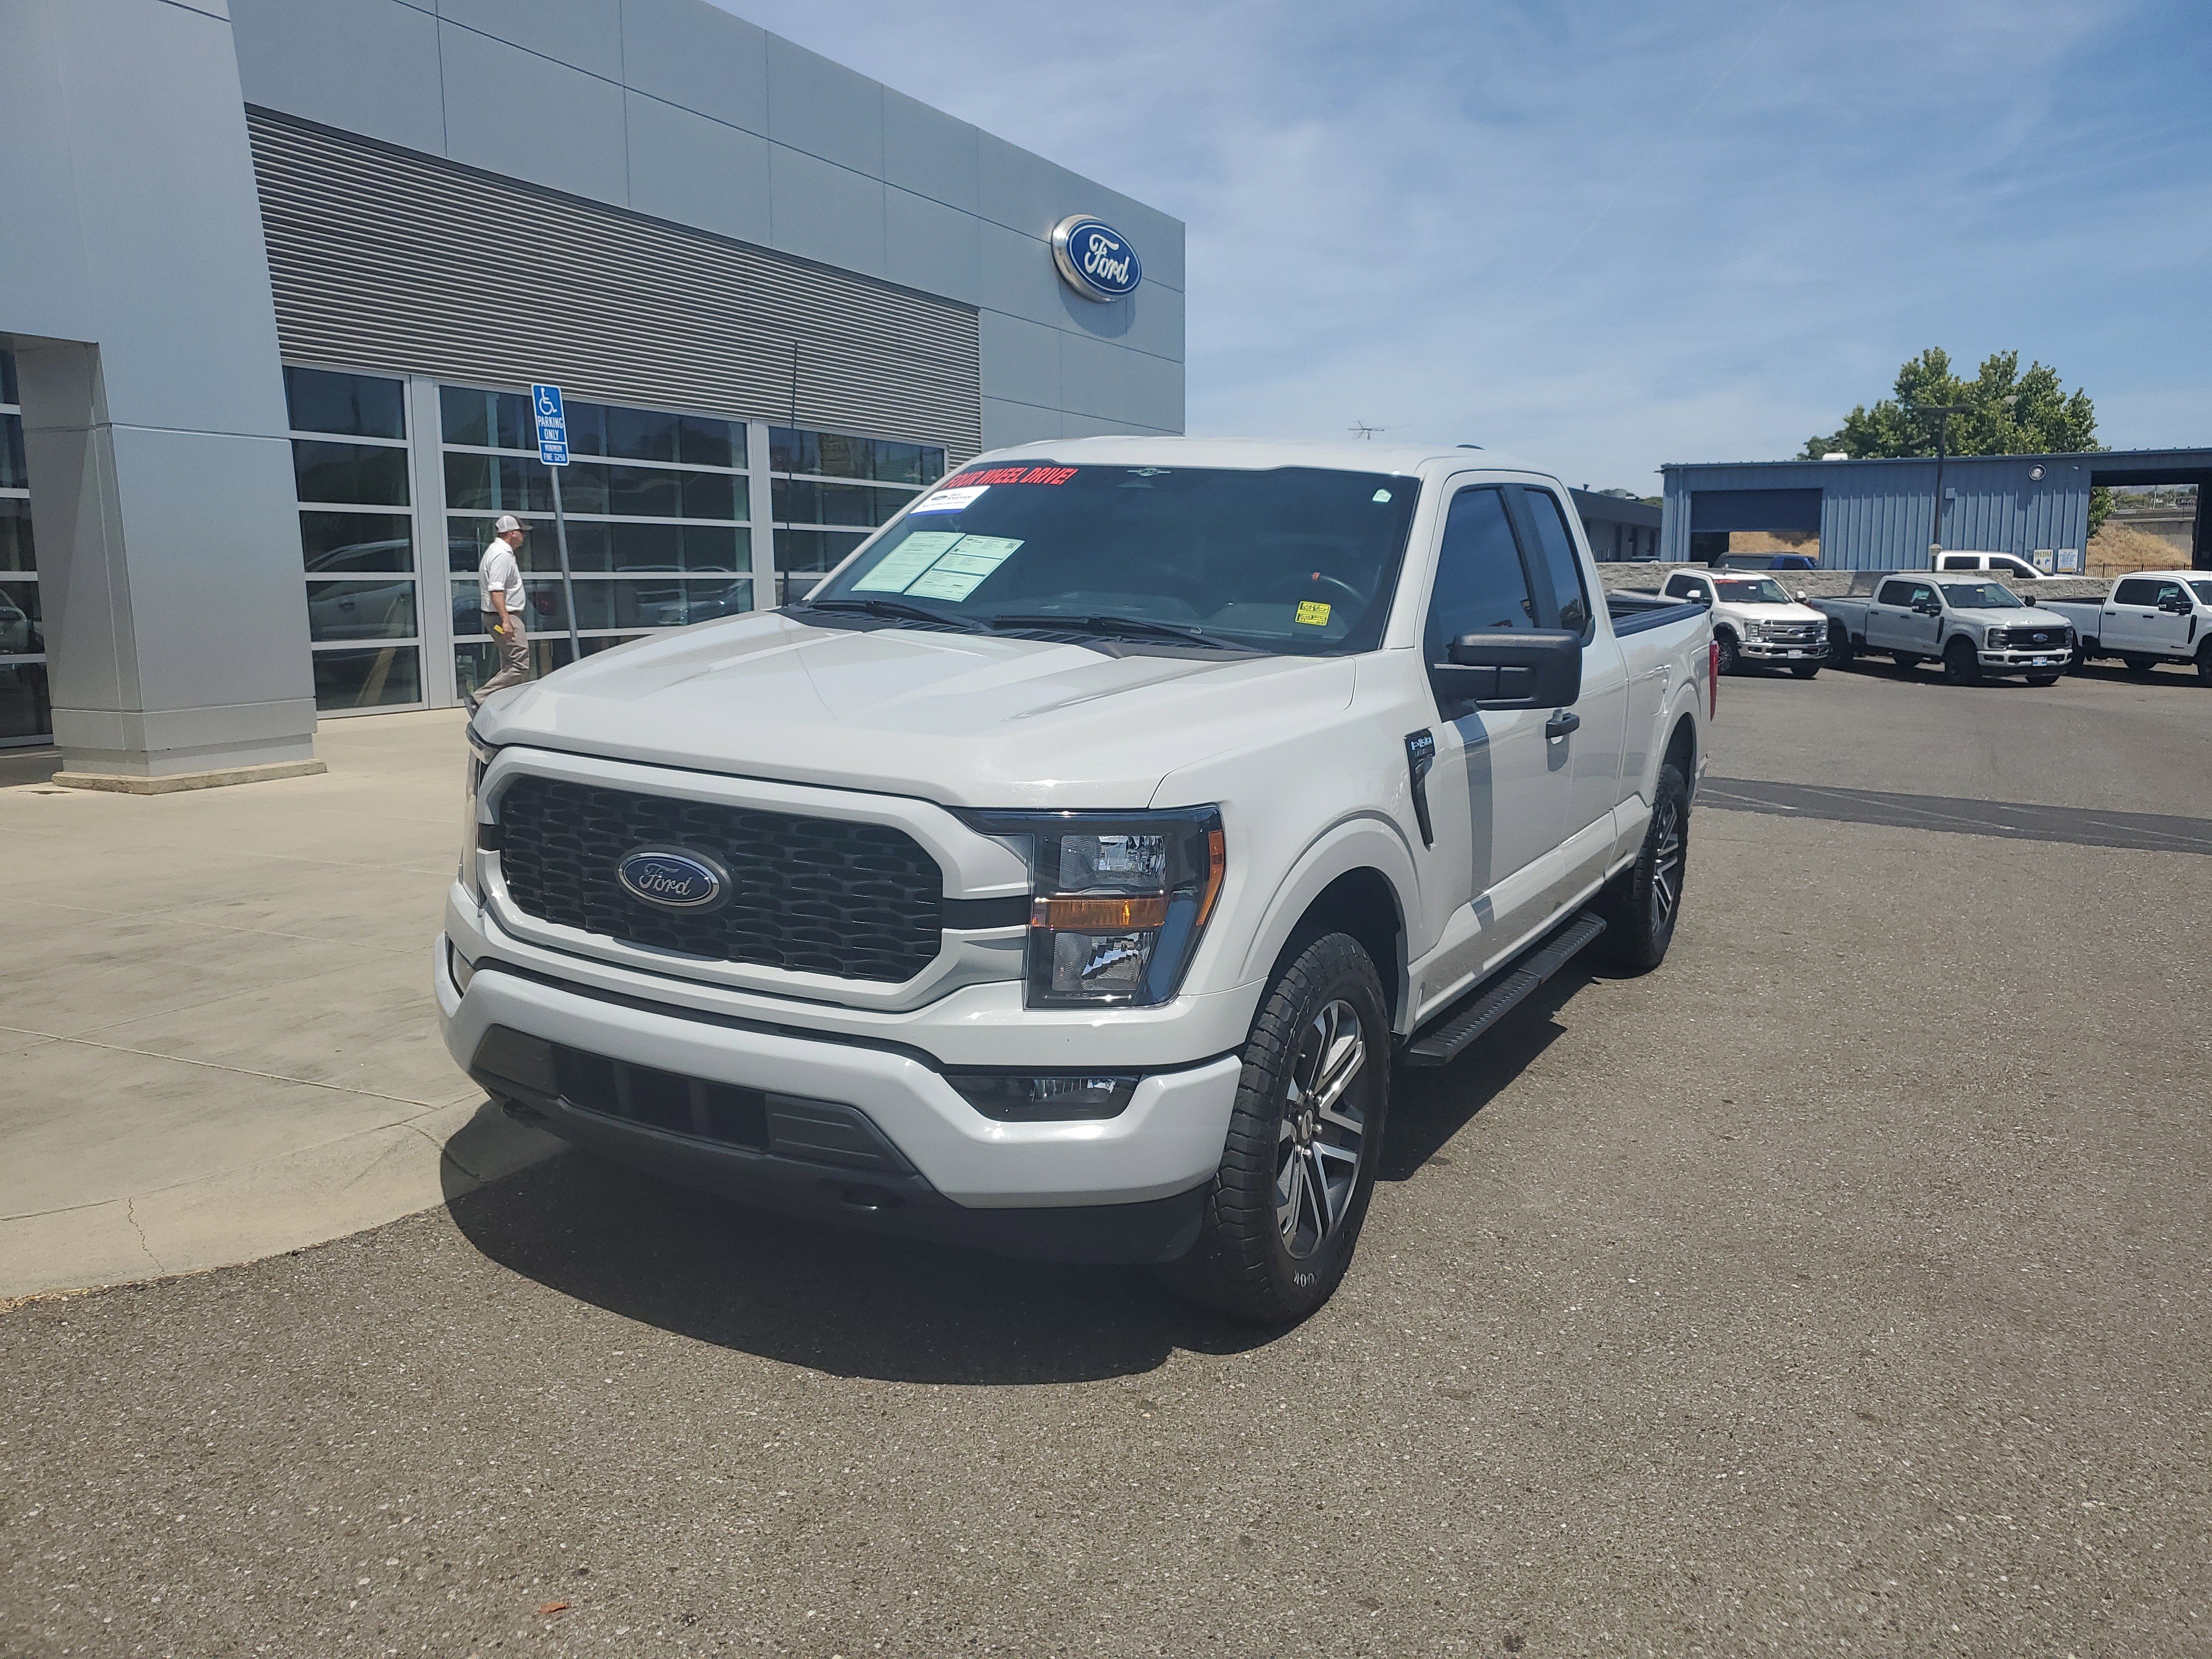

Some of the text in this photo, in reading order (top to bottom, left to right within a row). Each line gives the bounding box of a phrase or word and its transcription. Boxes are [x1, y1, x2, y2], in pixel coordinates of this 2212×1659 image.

[1084, 234, 1130, 285] Ford
[538, 415, 563, 429] PARKING
[544, 428, 559, 441] ONLY
[941, 467, 1079, 490] FOUR WHEEL DRIVE!
[639, 862, 693, 895] Ford
